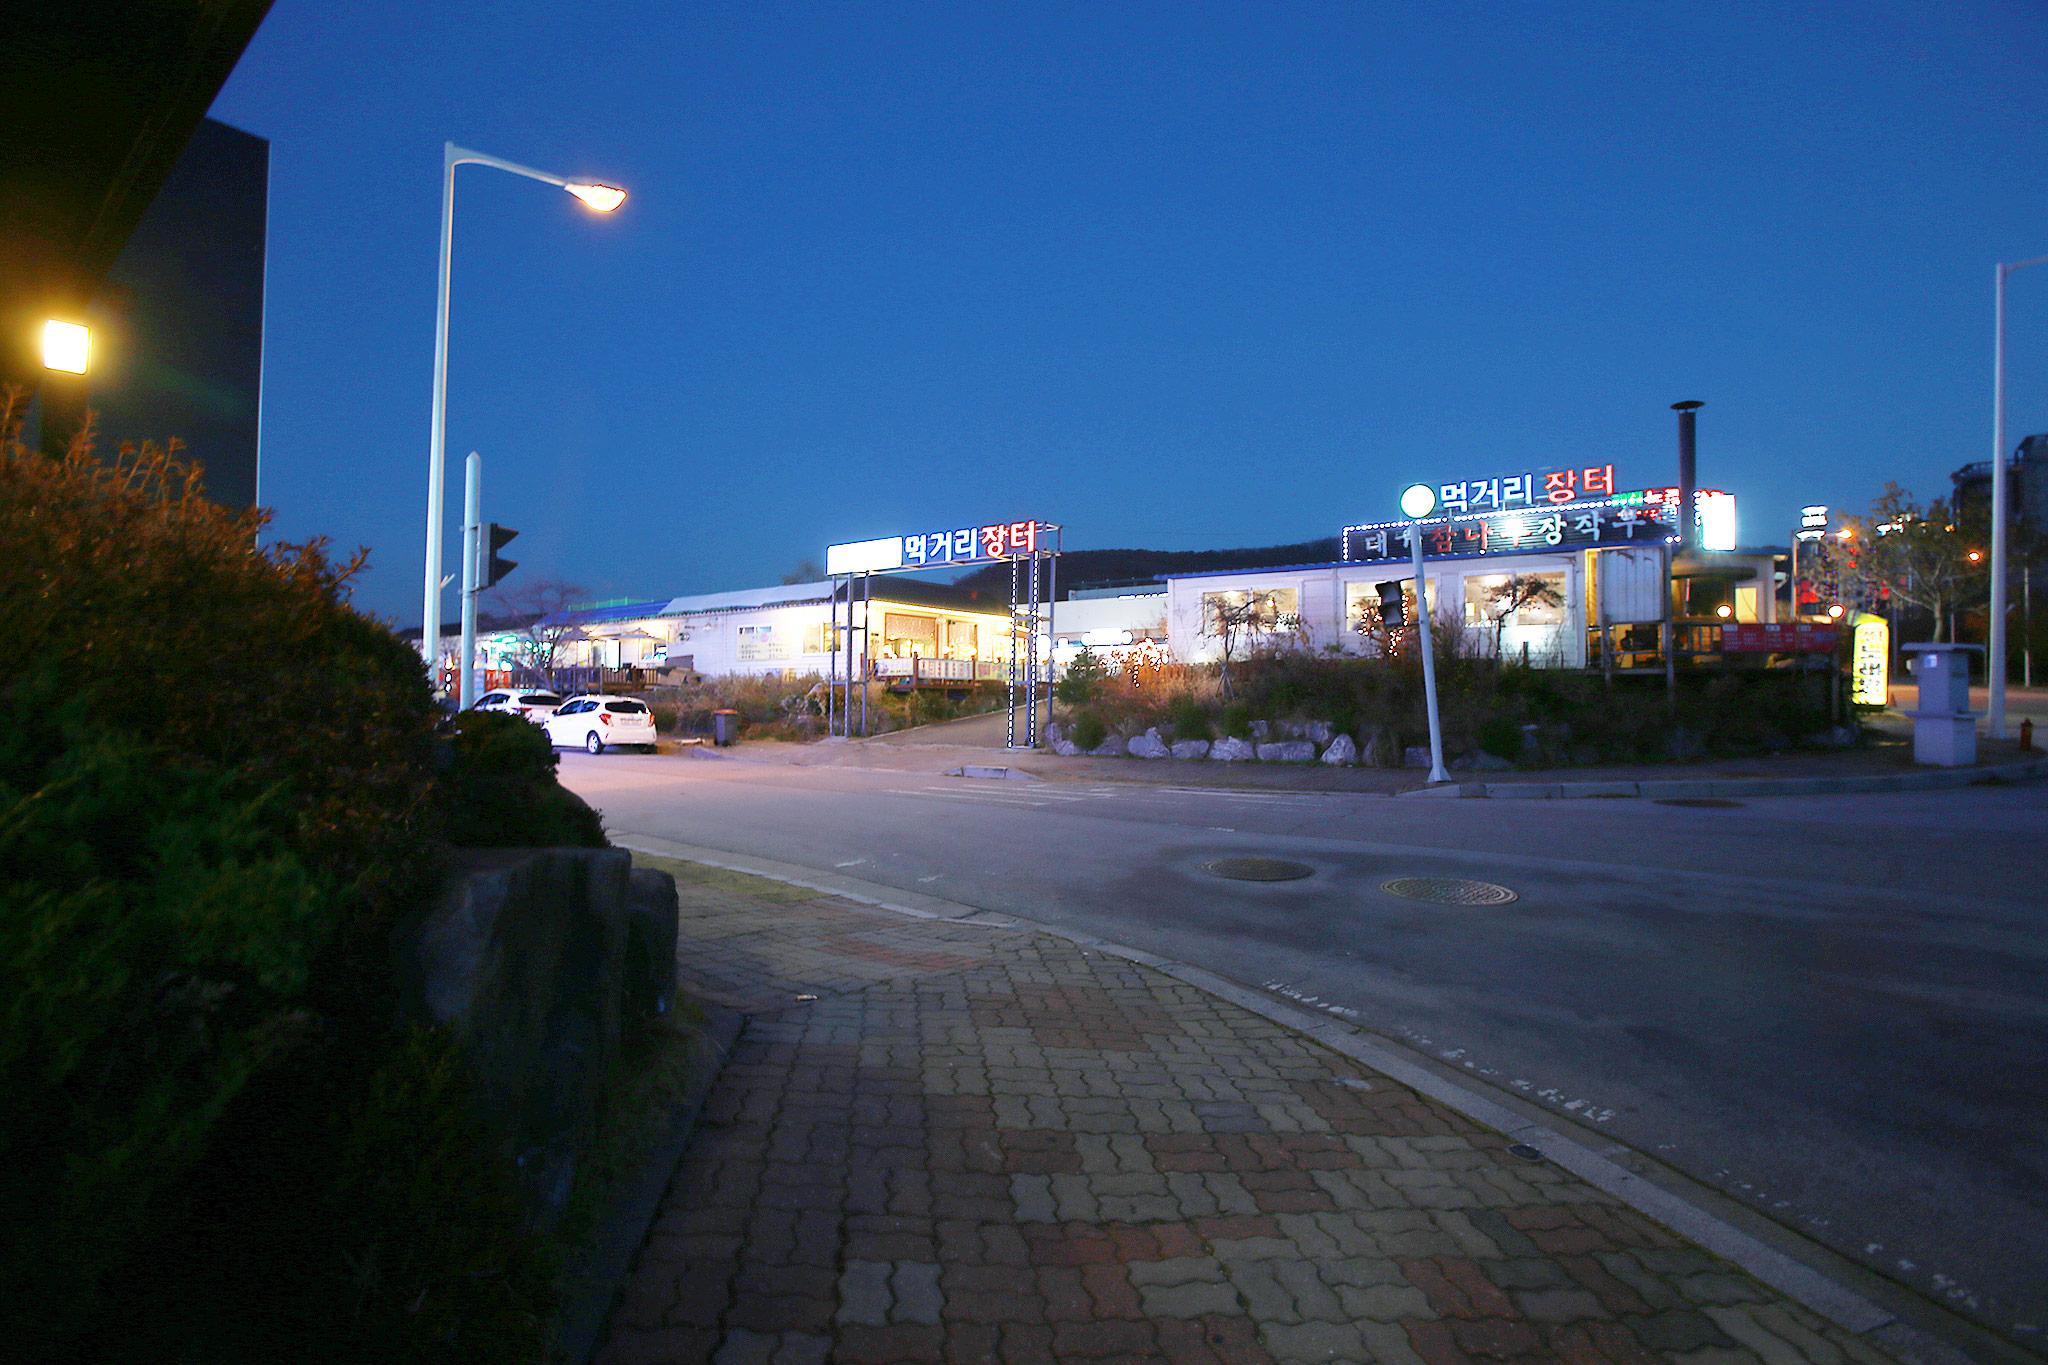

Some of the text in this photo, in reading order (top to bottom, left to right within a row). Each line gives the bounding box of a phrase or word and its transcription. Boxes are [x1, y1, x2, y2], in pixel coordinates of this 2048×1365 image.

[1440, 473, 1534, 511] 먹거리
[1543, 464, 1615, 503] 장터
[904, 520, 1037, 564] 먹거리 장터
